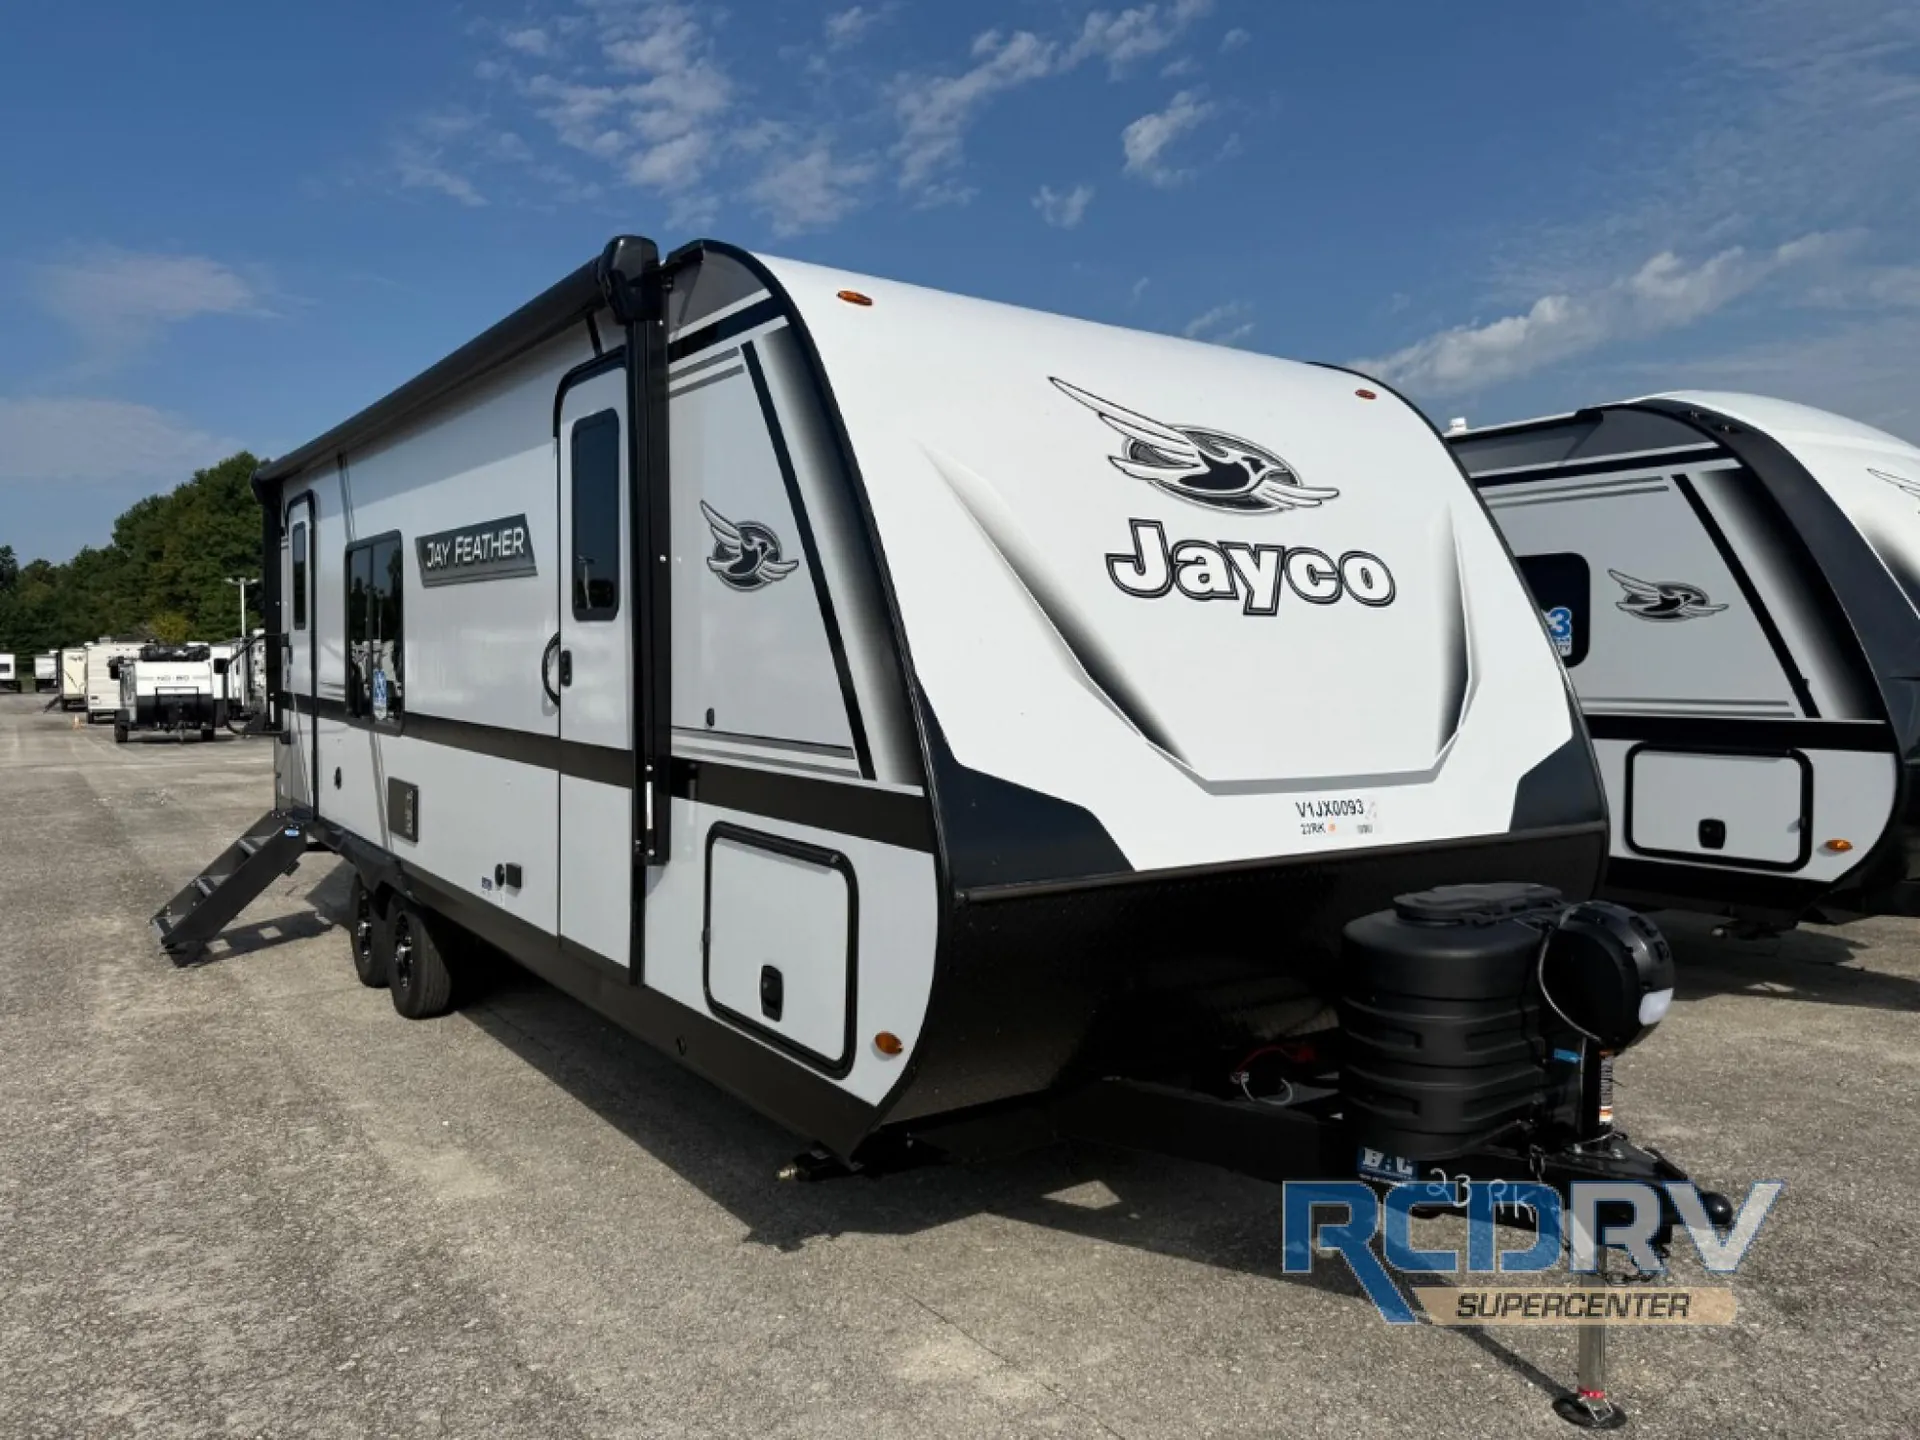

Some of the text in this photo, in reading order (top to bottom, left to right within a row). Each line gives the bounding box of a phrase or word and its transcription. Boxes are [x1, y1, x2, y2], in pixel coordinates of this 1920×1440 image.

[427, 526, 524, 568] JAY FEATHER
[1095, 517, 1396, 616] Jayco
[1295, 799, 1364, 818] V1JX0093
